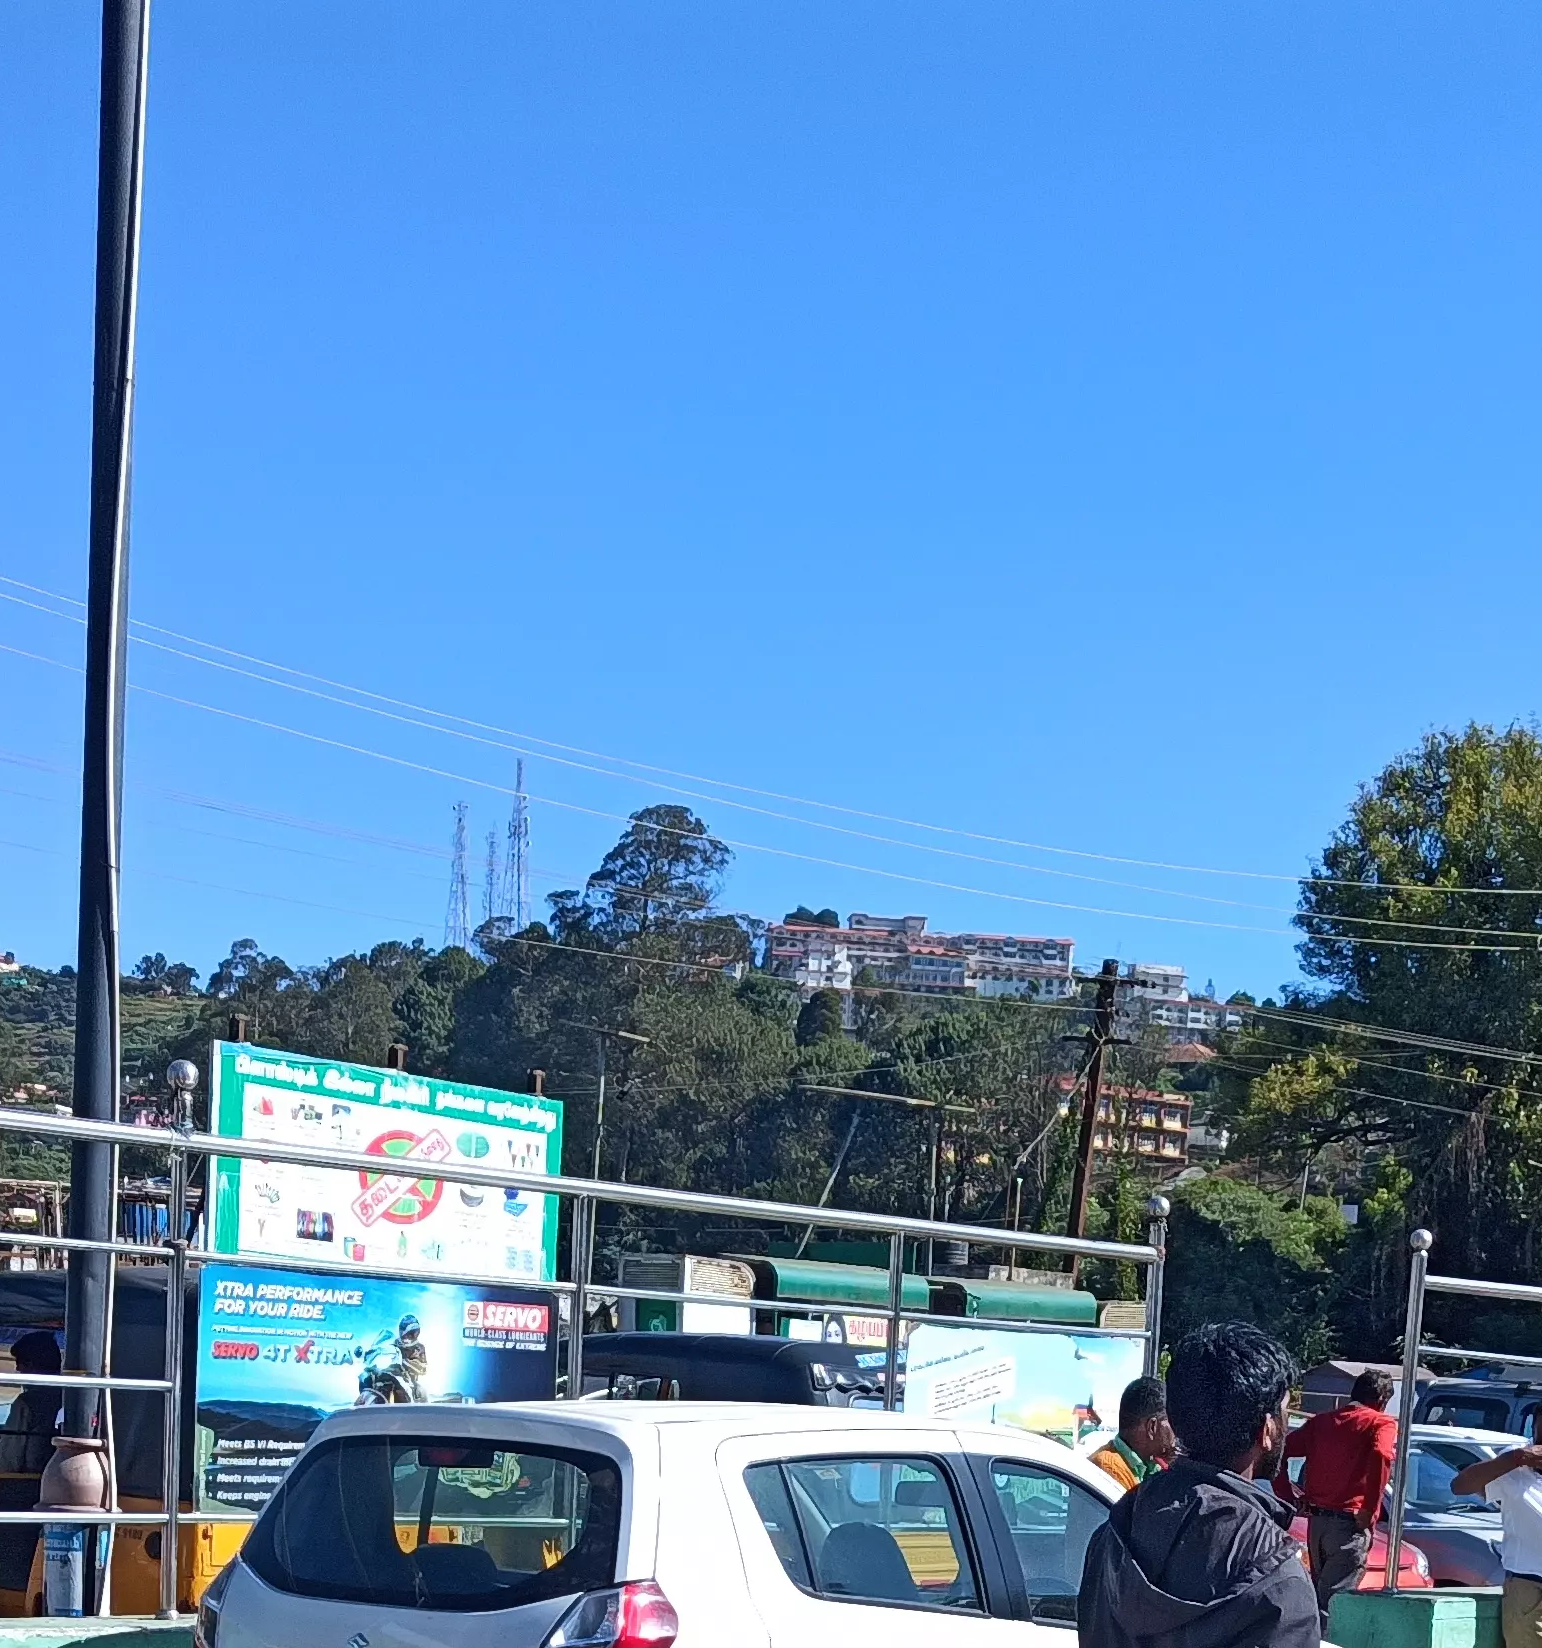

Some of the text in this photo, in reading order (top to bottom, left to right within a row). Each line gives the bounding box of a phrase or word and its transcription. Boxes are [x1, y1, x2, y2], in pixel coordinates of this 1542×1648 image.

[214, 1280, 364, 1305] XTRA PERFORMANCE
[214, 1298, 246, 1314] FOR
[249, 1301, 288, 1317] YOUR
[484, 1304, 542, 1330] SERVO
[213, 1341, 259, 1360] SERVO
[263, 1344, 291, 1363] 4T
[218, 1439, 243, 1449] Meets
[244, 1439, 257, 1449] BS
[216, 1456, 258, 1466] Increased
[216, 1473, 242, 1483] Meets
[216, 1491, 243, 1501] Keeps
